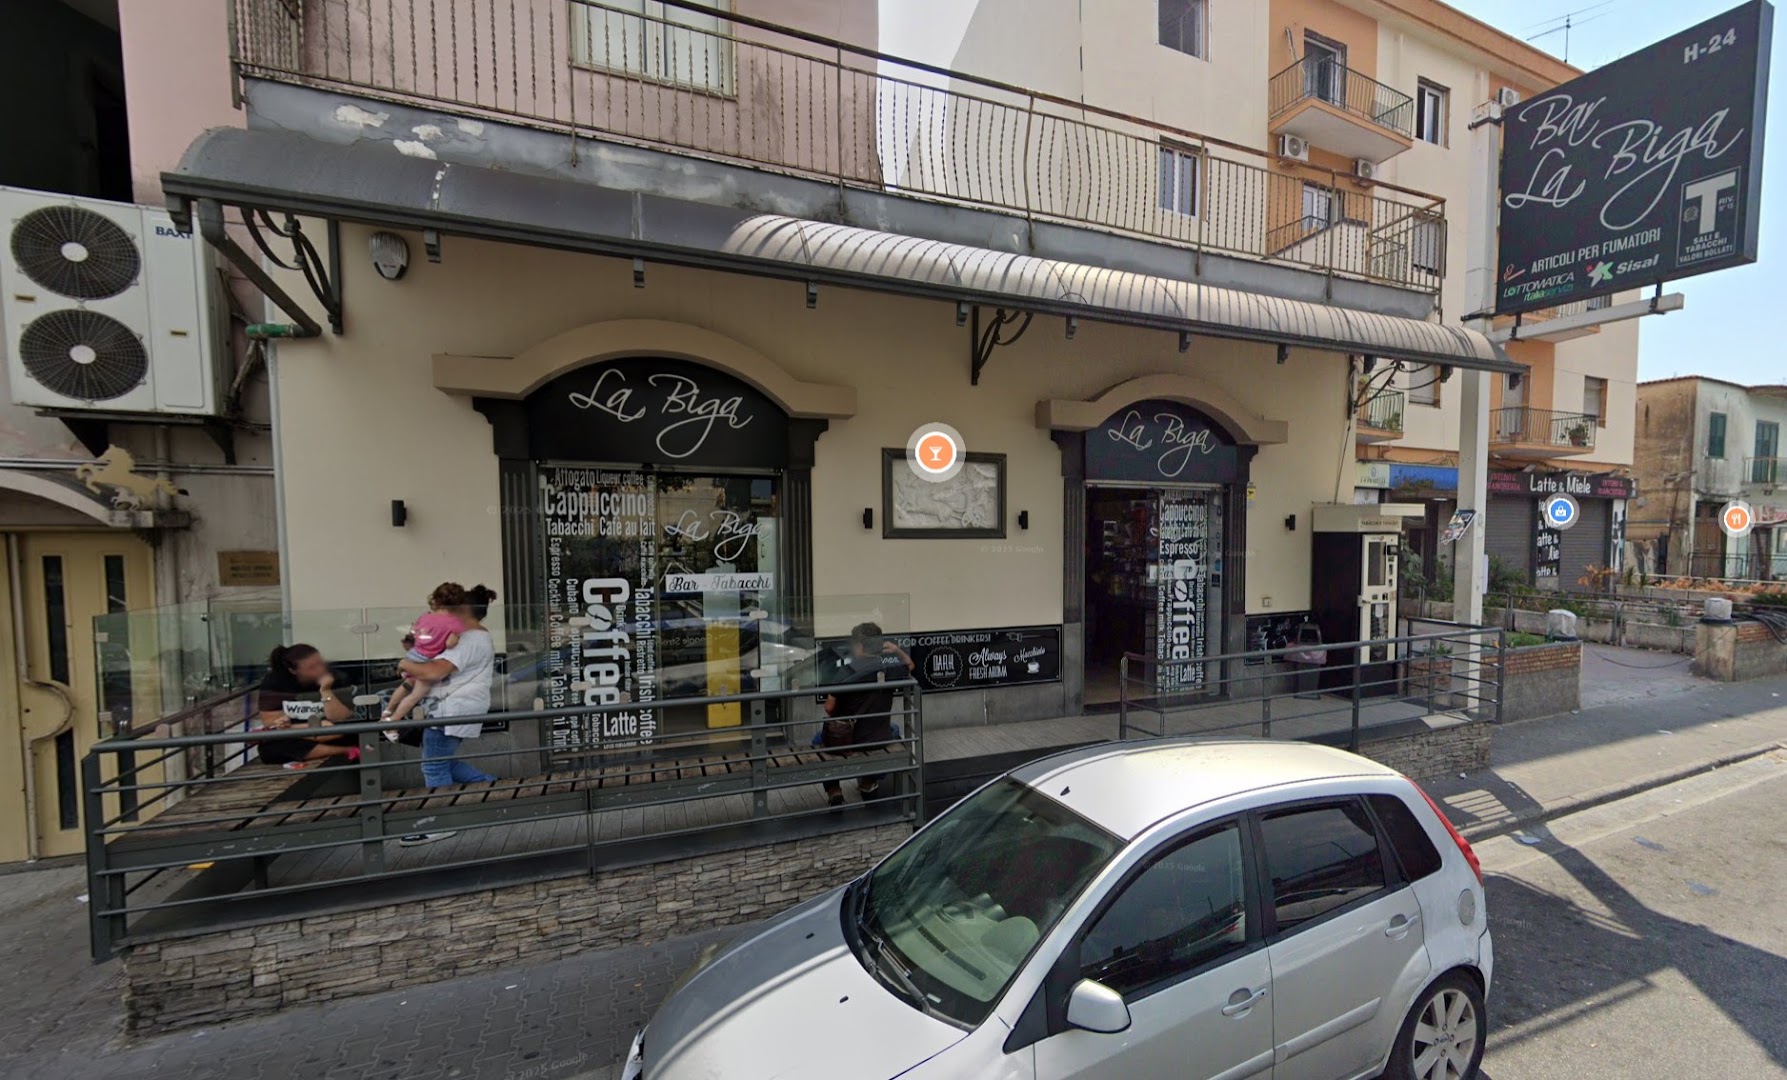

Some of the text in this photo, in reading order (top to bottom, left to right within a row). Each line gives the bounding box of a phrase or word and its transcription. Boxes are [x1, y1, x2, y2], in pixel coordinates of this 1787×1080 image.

[1683, 28, 1737, 64] H-24
[1518, 93, 1606, 150] Bar
[1505, 107, 1745, 231] La Biga
[1531, 227, 1661, 274] ARTICOLI PER FUMATORI
[1685, 237, 1728, 254] TABACCHI
[1704, 244, 1734, 261] BOLLATI
[1616, 254, 1660, 275] Sisal
[1503, 271, 1575, 298] LOTTOMATICA
[568, 368, 754, 458] La Biga
[1108, 410, 1216, 477] La Biga
[1530, 474, 1591, 494] Latte & Miele
[544, 483, 647, 522] Cappuccino
[545, 517, 594, 536] Tabacchi
[625, 520, 637, 536] au
[640, 516, 656, 536] lait
[664, 509, 769, 561] La Biga
[548, 537, 562, 577] Espresso
[1159, 540, 1198, 557] Espresso
[548, 578, 561, 613] Cocktail
[565, 578, 579, 614] Cubano
[669, 575, 699, 592] Bar
[710, 573, 771, 591] Tabacchi
[635, 587, 655, 640] Tabacchi
[550, 614, 564, 648] Coffee
[897, 635, 917, 648] FOR
[918, 634, 950, 647] COFFEE
[550, 650, 564, 673] milk
[968, 646, 1008, 667] Always
[969, 666, 988, 680] FRESH
[988, 664, 1008, 679] AROMA
[1179, 664, 1196, 683] Latte
[639, 675, 656, 702] Irish
[603, 712, 637, 737] Latte
